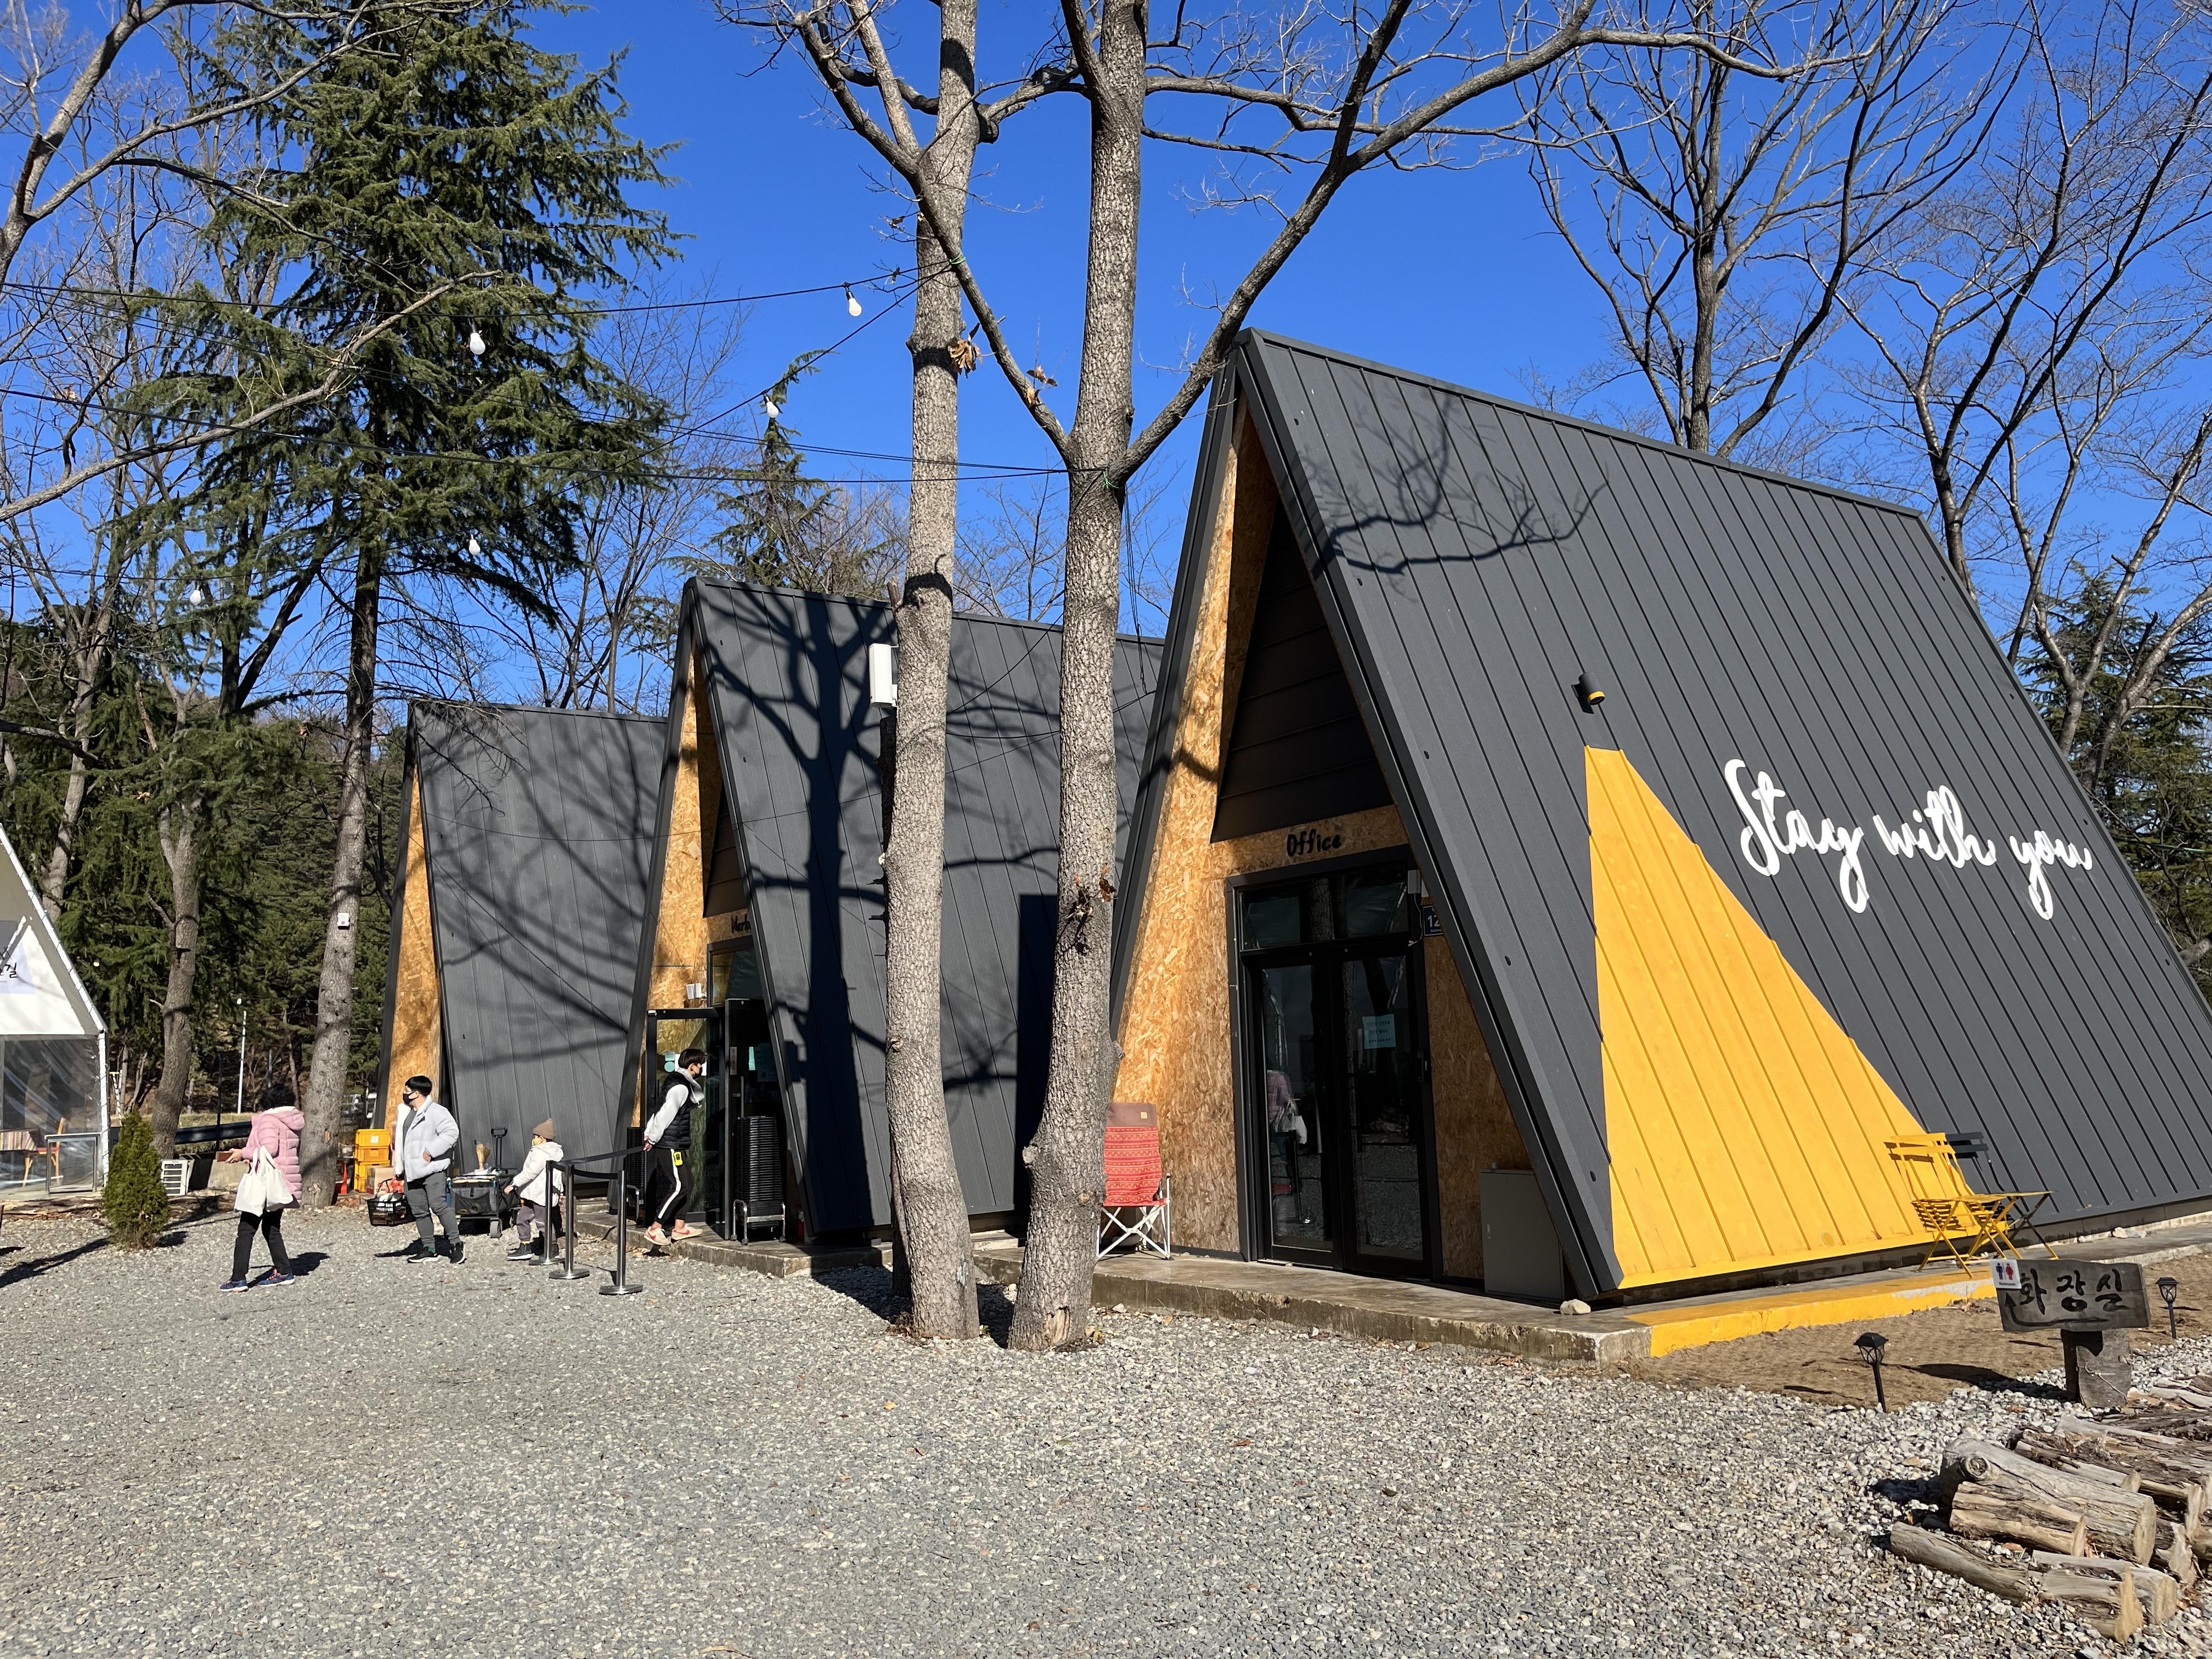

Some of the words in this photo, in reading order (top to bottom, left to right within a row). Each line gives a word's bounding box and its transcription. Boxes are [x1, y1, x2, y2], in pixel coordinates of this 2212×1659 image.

[1286, 829, 1341, 857] Office
[1724, 759, 1869, 913] Stay
[1872, 785, 1997, 868] with
[2009, 830, 2092, 920] you
[2019, 1268, 2130, 1314] 화장실
